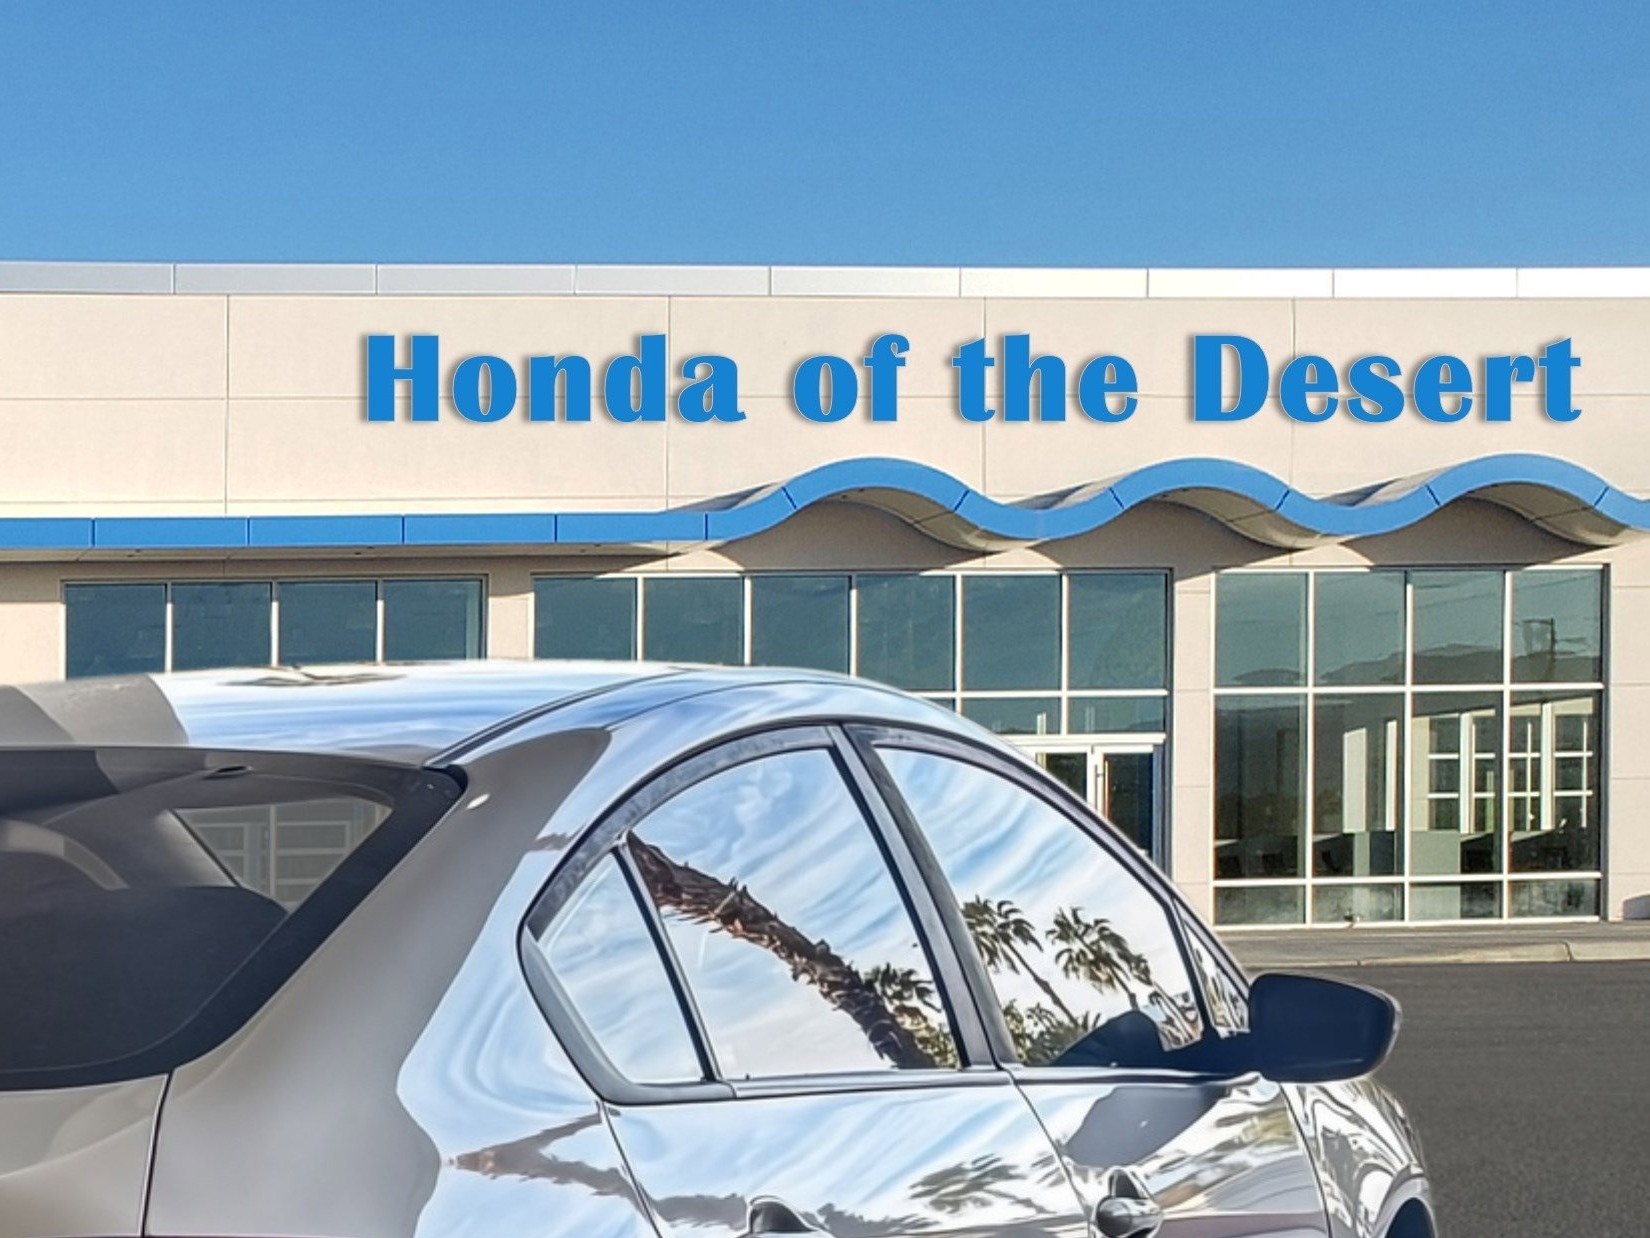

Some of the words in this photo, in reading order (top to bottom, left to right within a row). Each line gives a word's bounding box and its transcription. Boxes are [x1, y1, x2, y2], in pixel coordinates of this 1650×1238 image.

[366, 333, 747, 423] Honda
[793, 333, 911, 423] of
[952, 333, 1138, 423] the
[1193, 334, 1582, 423] Desert
